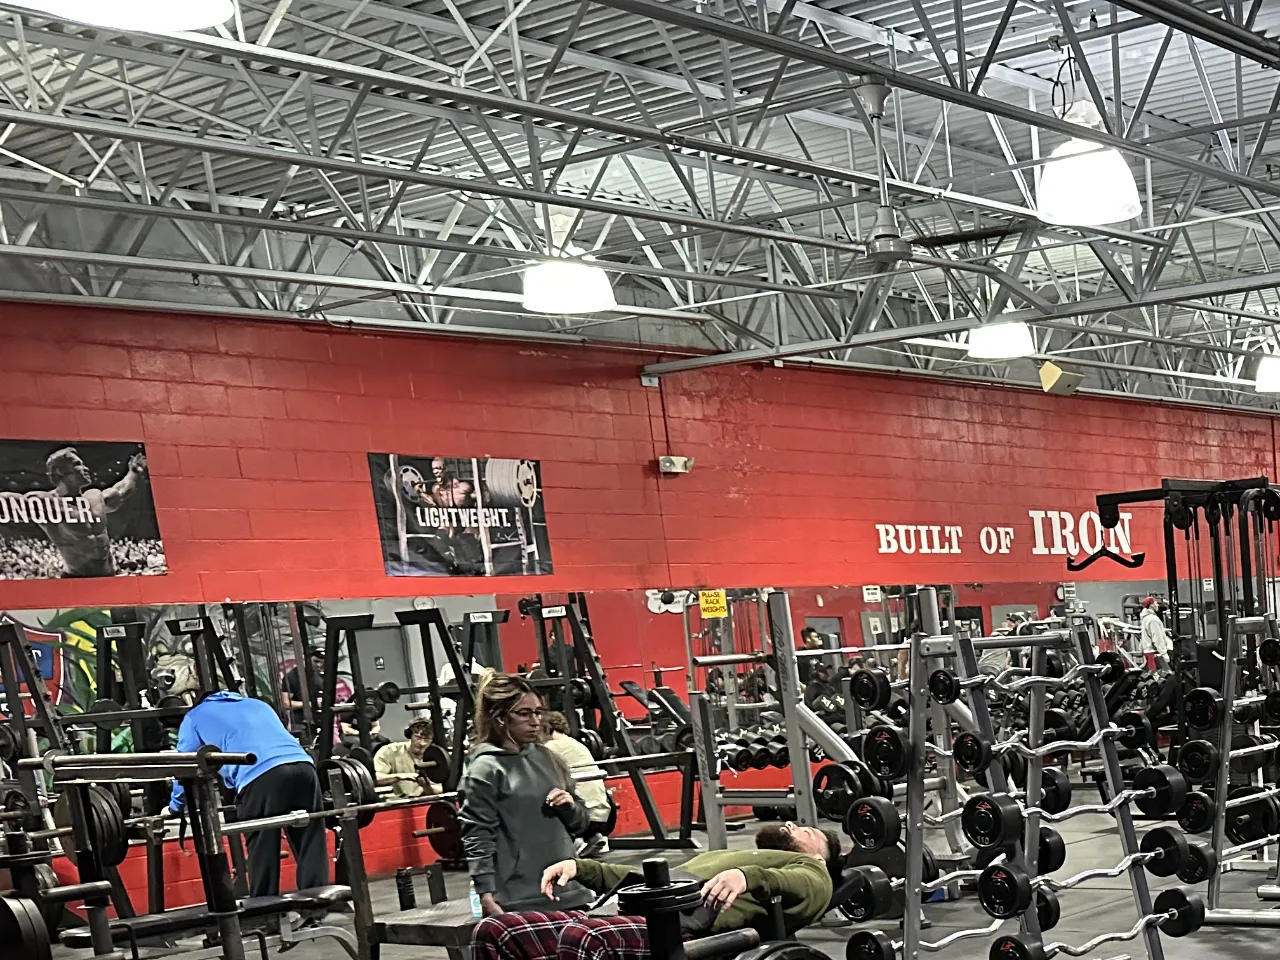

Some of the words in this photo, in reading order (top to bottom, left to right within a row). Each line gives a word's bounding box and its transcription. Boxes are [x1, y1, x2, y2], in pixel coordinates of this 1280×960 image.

[875, 523, 963, 554] BUILT
[980, 526, 1015, 554] OF
[1028, 510, 1133, 555] IRON
[976, 835, 990, 844] 110
[853, 907, 866, 916] 100
